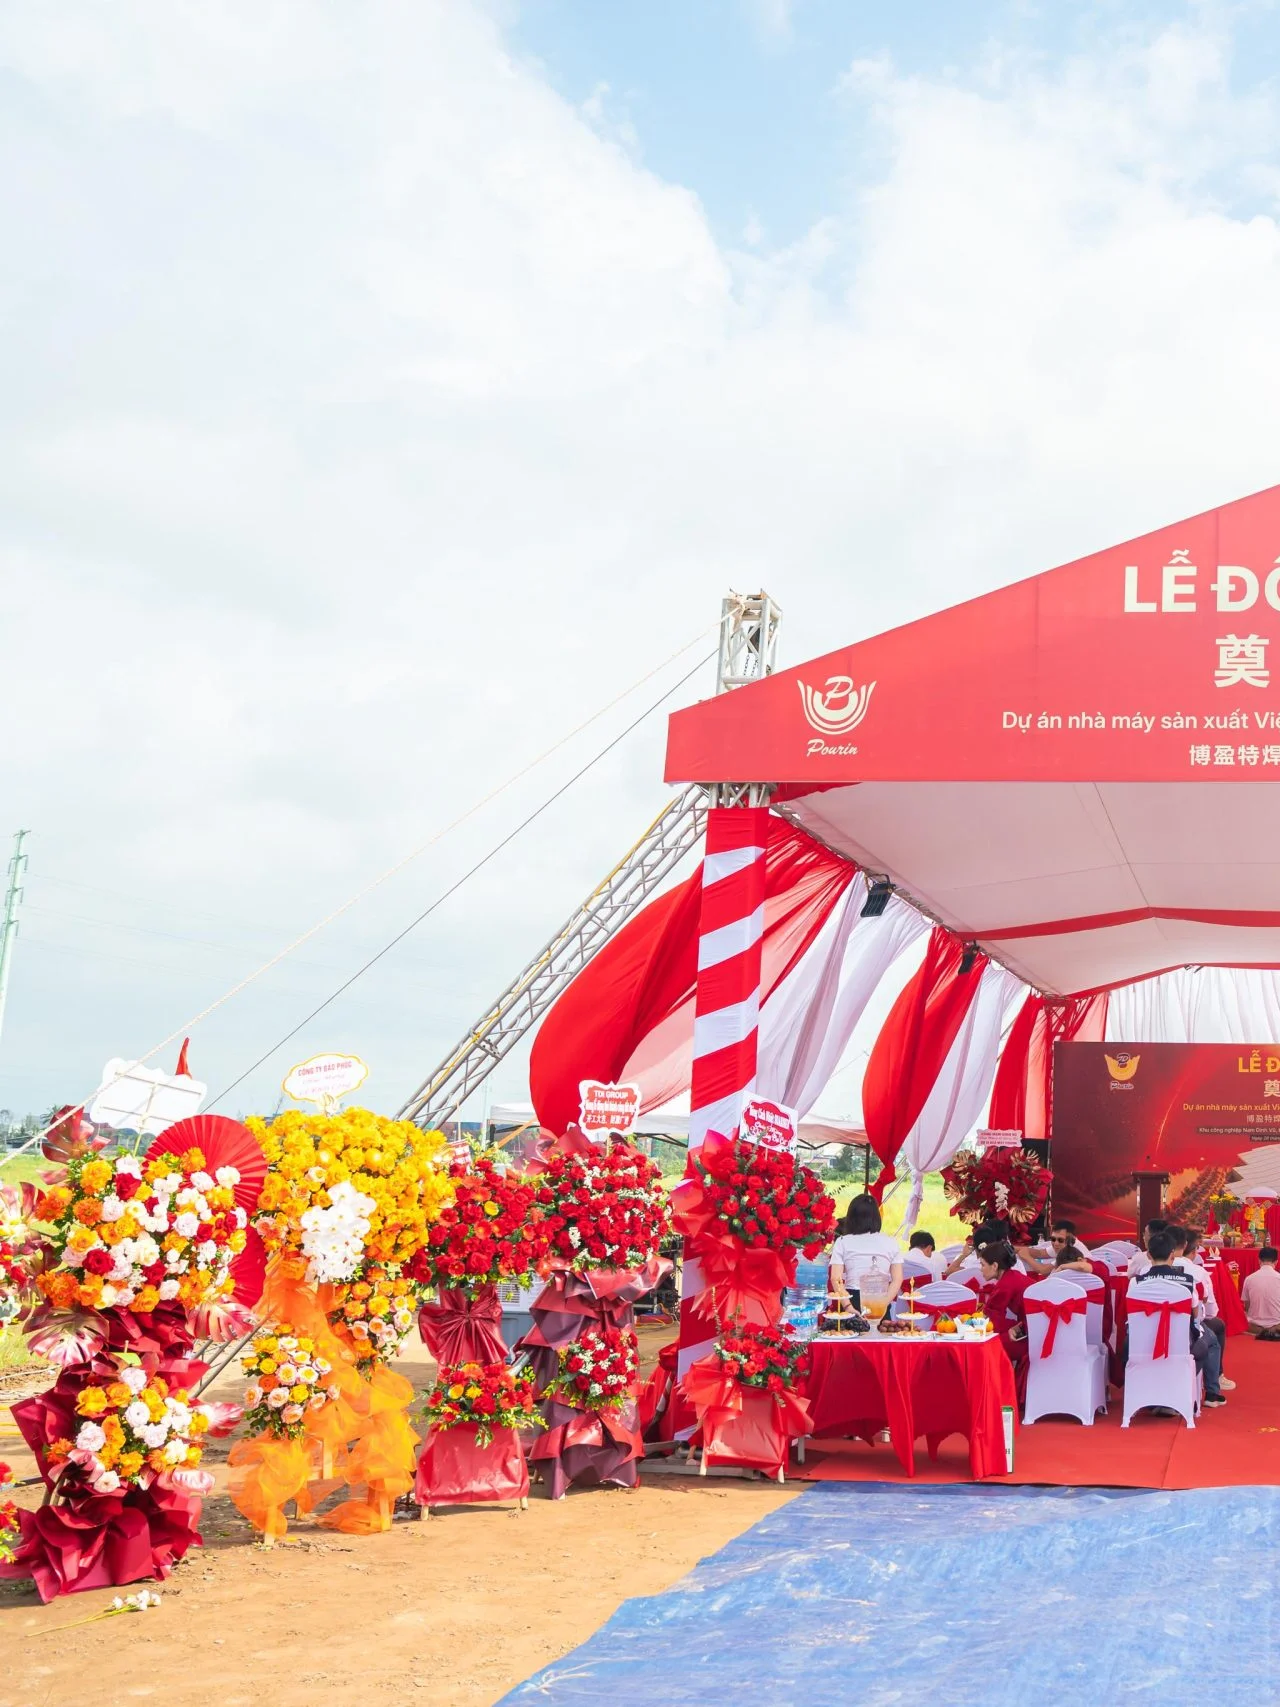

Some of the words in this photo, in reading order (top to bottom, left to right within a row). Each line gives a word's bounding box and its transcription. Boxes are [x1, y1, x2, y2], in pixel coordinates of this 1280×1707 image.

[1123, 549, 1198, 614] LỄ
[1002, 711, 1032, 734] Dự
[1037, 711, 1063, 730] án
[1068, 711, 1106, 730] nhà
[1112, 711, 1155, 733] máy
[1161, 711, 1198, 730] sản
[1203, 708, 1249, 730] xuất
[806, 738, 859, 757] Pourin
[1238, 1049, 1261, 1073] LỄ
[606, 1091, 629, 1099] GROUP
[1183, 1103, 1195, 1112] Dự
[1206, 1103, 1220, 1111] nhà
[1221, 1103, 1237, 1112] máy
[1254, 1102, 1270, 1111] xuất
